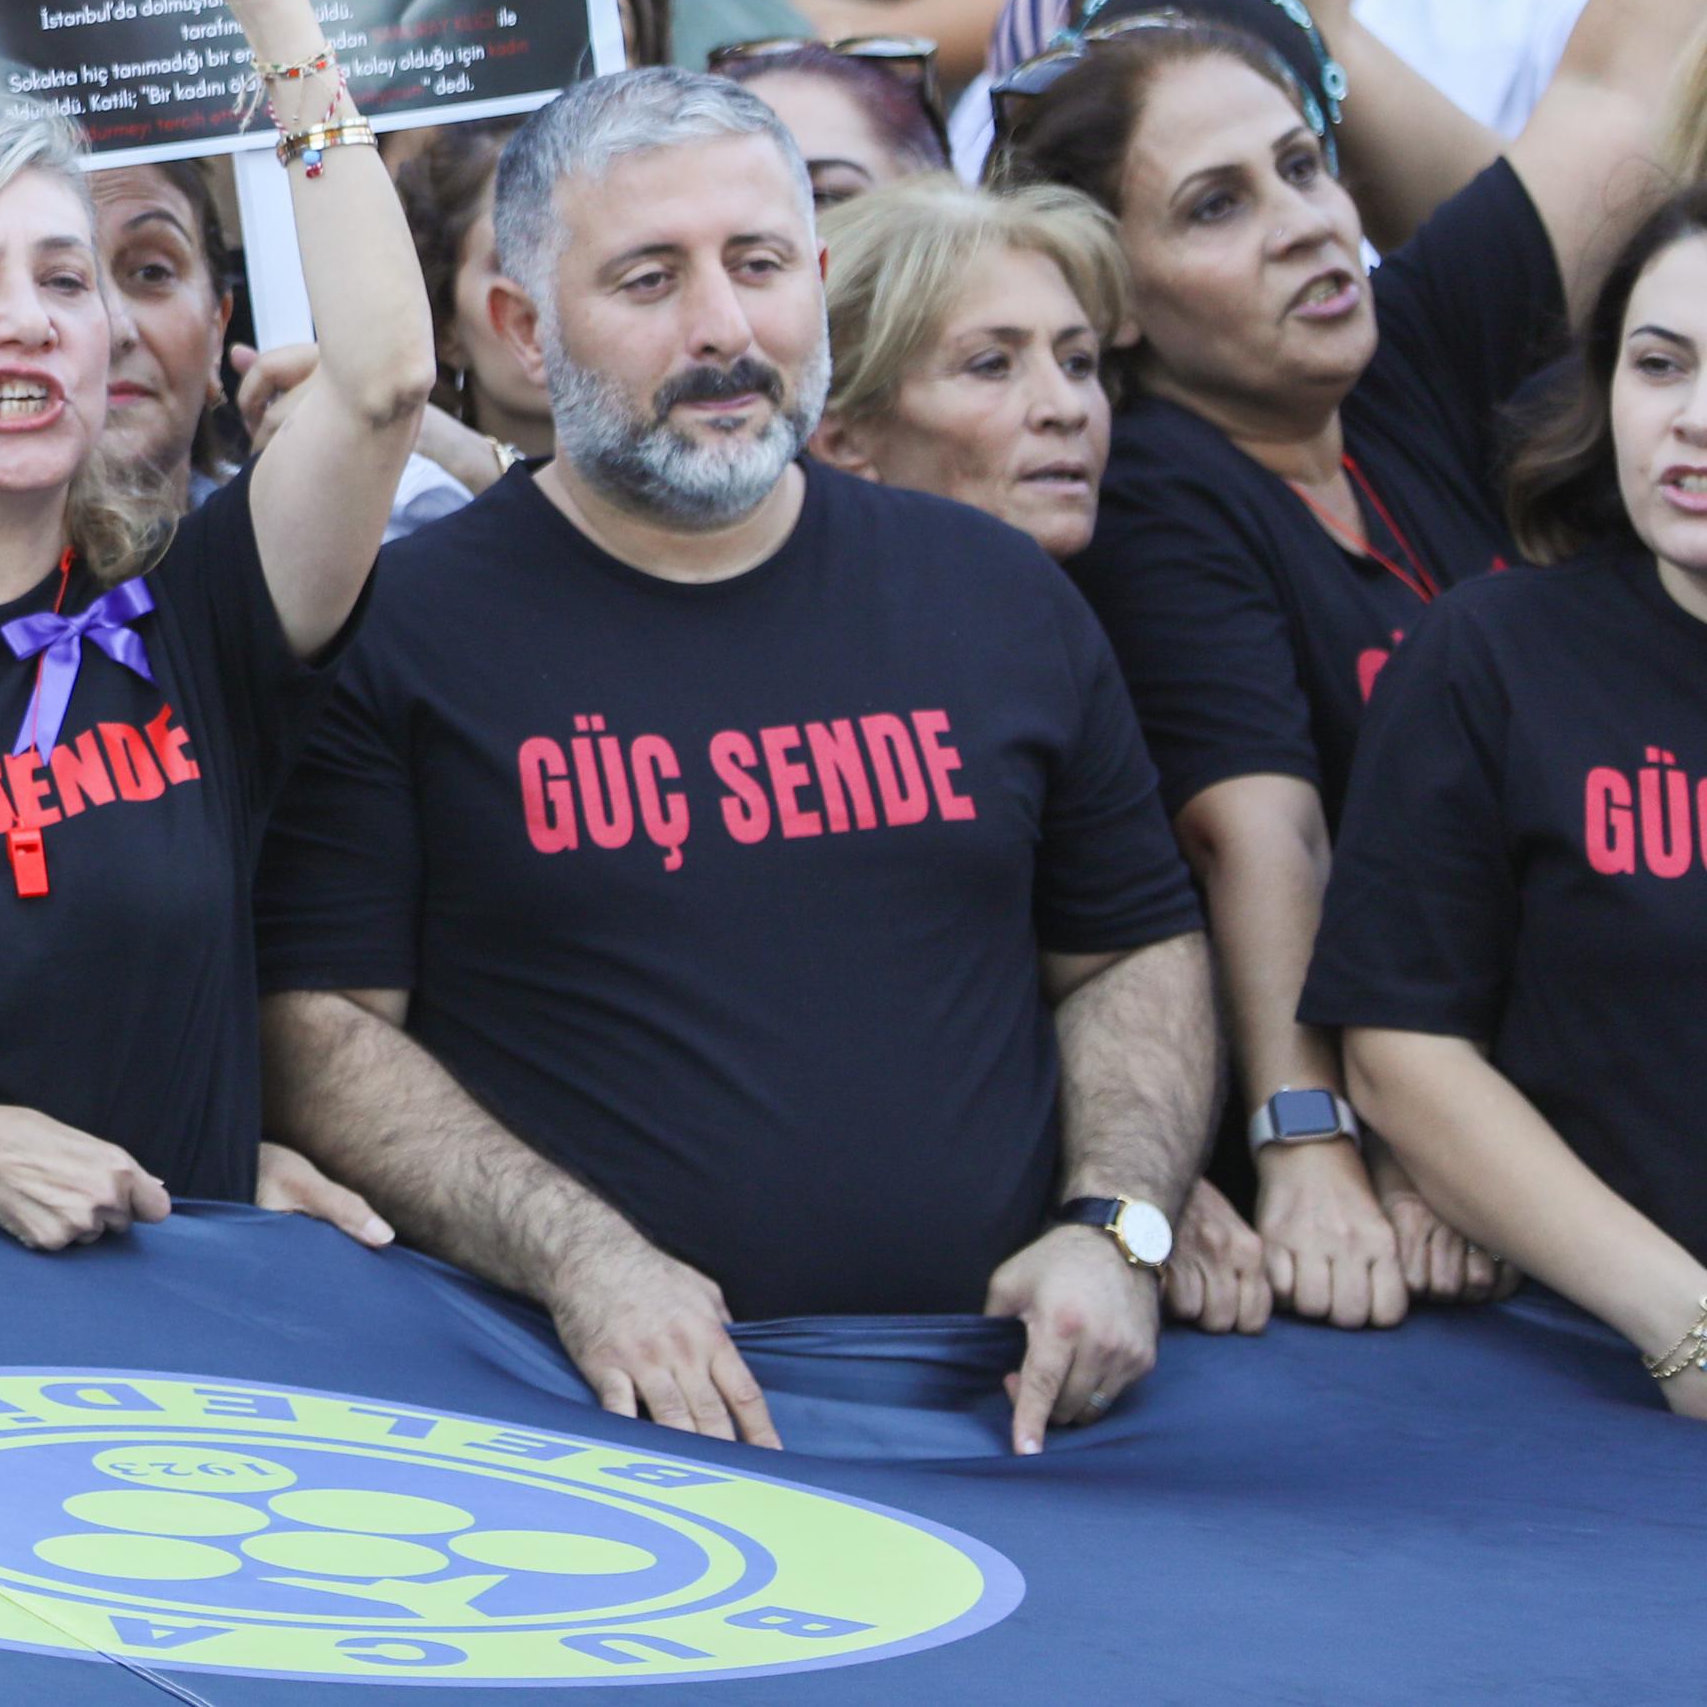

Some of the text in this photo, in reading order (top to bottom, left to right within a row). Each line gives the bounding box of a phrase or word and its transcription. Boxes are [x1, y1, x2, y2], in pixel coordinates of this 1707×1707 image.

[9, 67, 78, 94] Sokakta
[80, 59, 109, 86] hiç
[112, 50, 204, 80] tanımadığı
[205, 47, 230, 66] bir
[497, 5, 519, 29] ile
[89, 86, 138, 114] Katili;
[174, 78, 226, 101] kadını
[352, 55, 396, 79] kolay
[398, 47, 454, 72] olduğu
[457, 44, 486, 67] için
[517, 709, 976, 872] GÜÇ SENDE
[108, 1461, 275, 1478] 1923
[108, 1604, 878, 1669] BUCA
